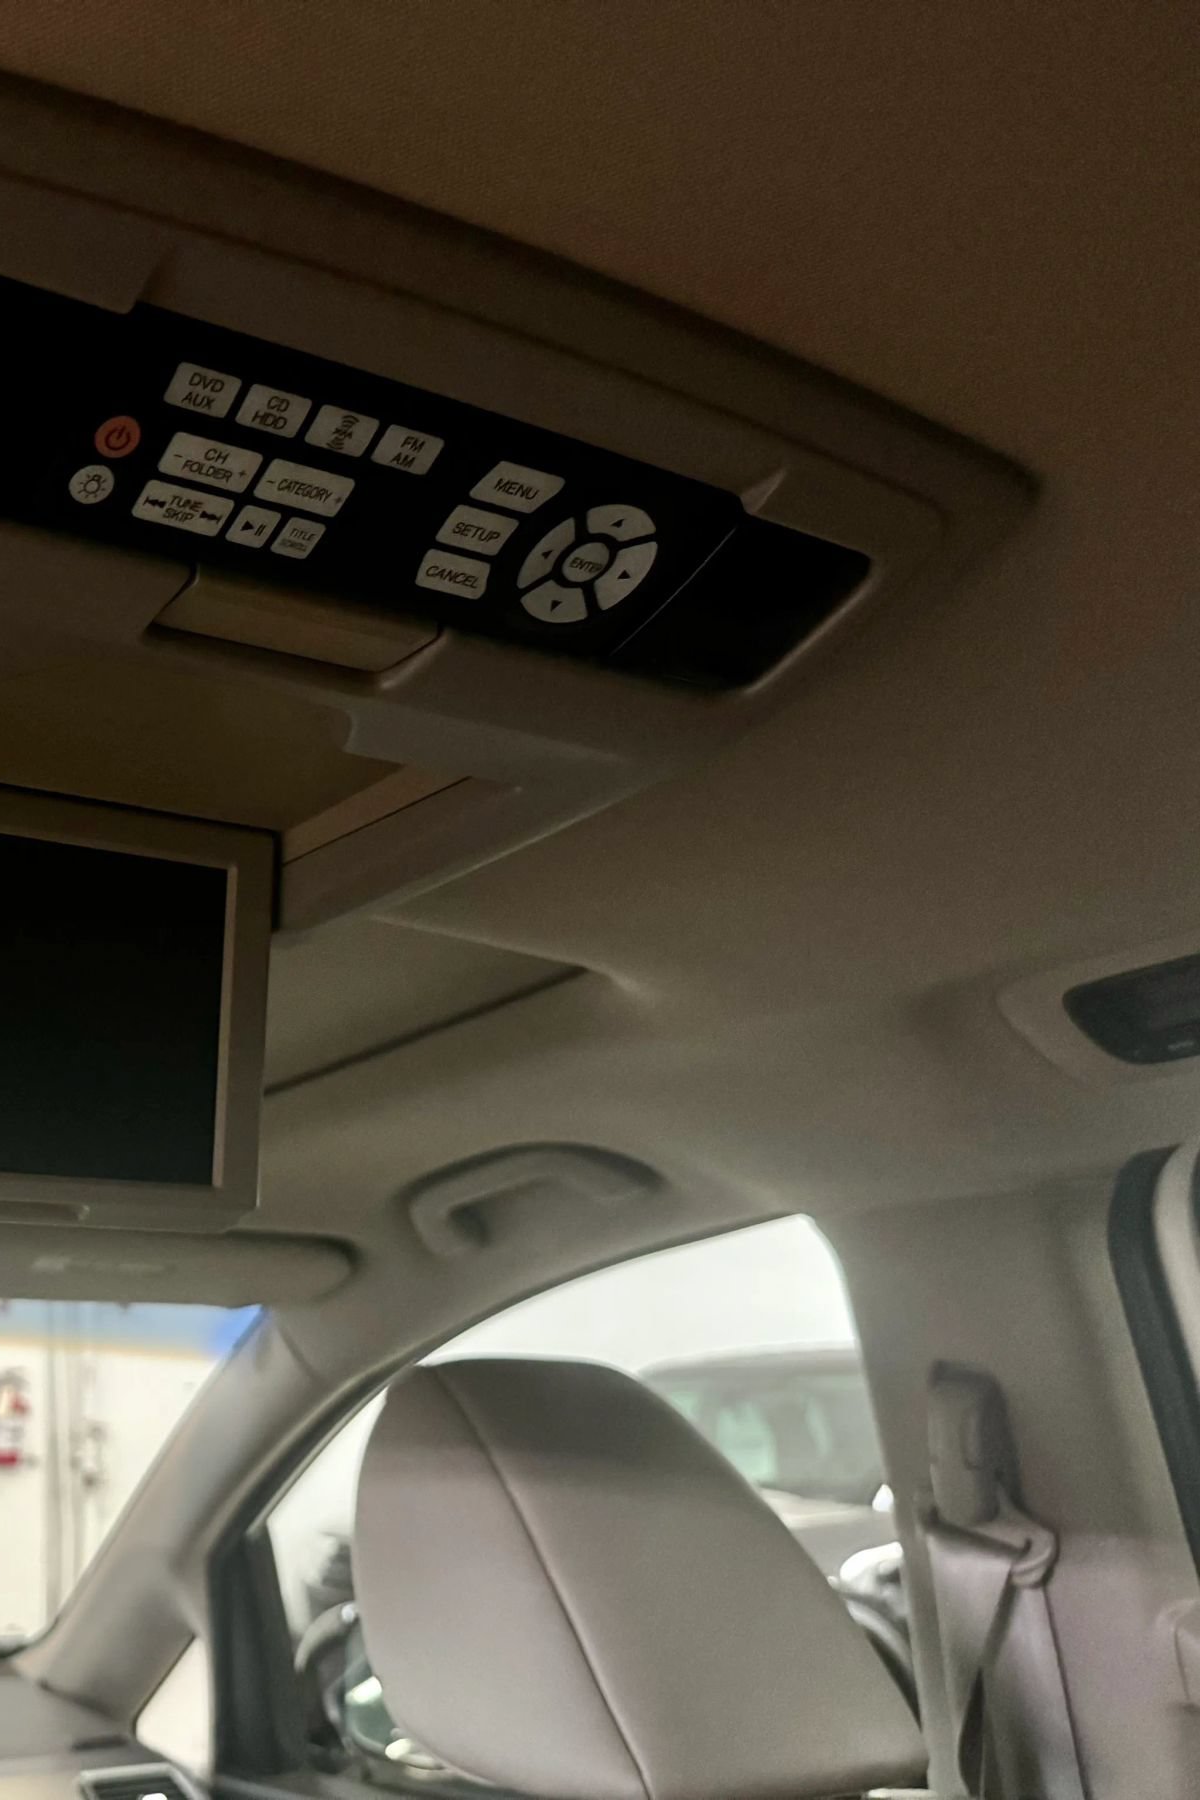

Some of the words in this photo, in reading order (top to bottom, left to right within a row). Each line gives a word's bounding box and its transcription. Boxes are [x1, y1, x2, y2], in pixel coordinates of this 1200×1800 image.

[189, 372, 225, 393] DVD
[181, 391, 216, 410] AUX
[266, 395, 290, 413] CD
[252, 411, 287, 430] HDD
[401, 436, 426, 453] FM
[204, 448, 231, 464] CH
[390, 452, 416, 468] AM
[182, 460, 232, 483] FOLDER
[277, 478, 334, 504] CATEGORY
[494, 478, 540, 501] MENU
[169, 494, 204, 513] TUNE
[163, 507, 194, 523] SKIP
[452, 520, 501, 544] SETUP
[425, 564, 480, 589] CANCEL
